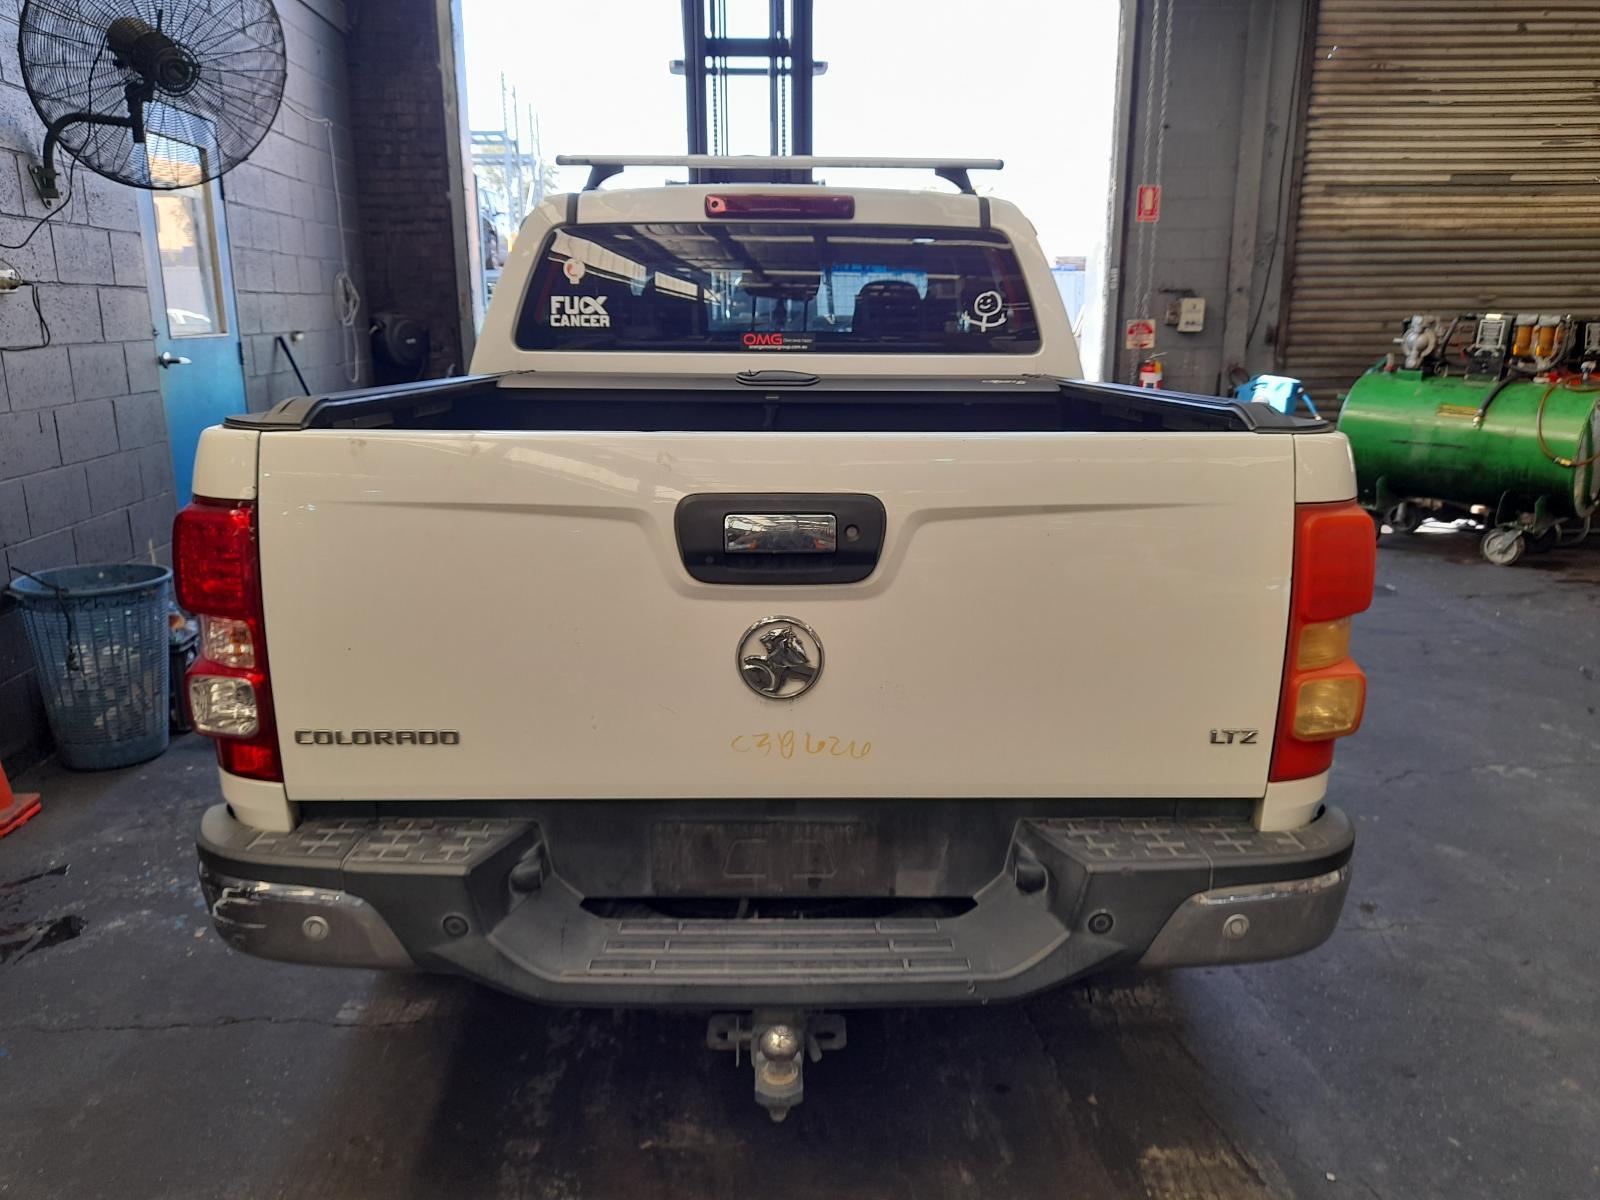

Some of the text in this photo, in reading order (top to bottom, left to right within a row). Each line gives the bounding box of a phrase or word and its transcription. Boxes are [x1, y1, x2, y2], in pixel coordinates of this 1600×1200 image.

[550, 314, 610, 328] CANCER
[743, 333, 783, 346] OMG
[294, 729, 460, 746] COLORADO
[1209, 728, 1259, 744] LTZ
